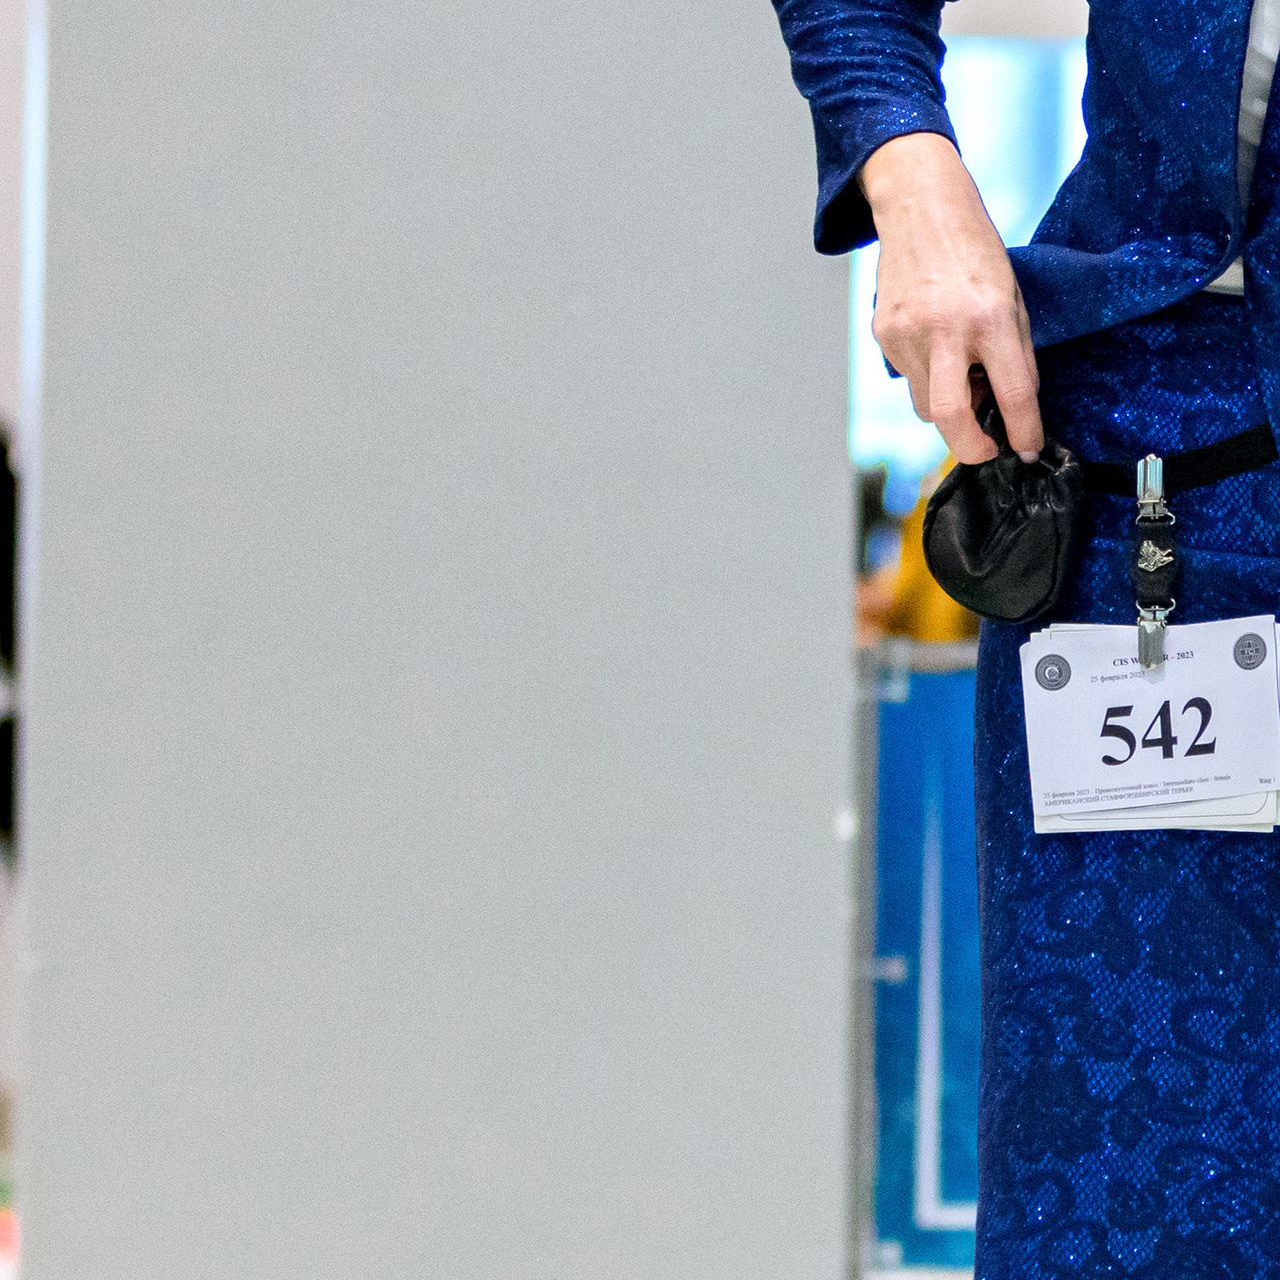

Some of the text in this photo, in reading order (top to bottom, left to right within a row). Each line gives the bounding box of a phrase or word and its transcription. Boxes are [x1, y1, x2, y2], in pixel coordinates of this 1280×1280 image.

[1112, 657, 1129, 667] CIS
[1176, 651, 1194, 661] 2023
[1099, 696, 1217, 766] 542
